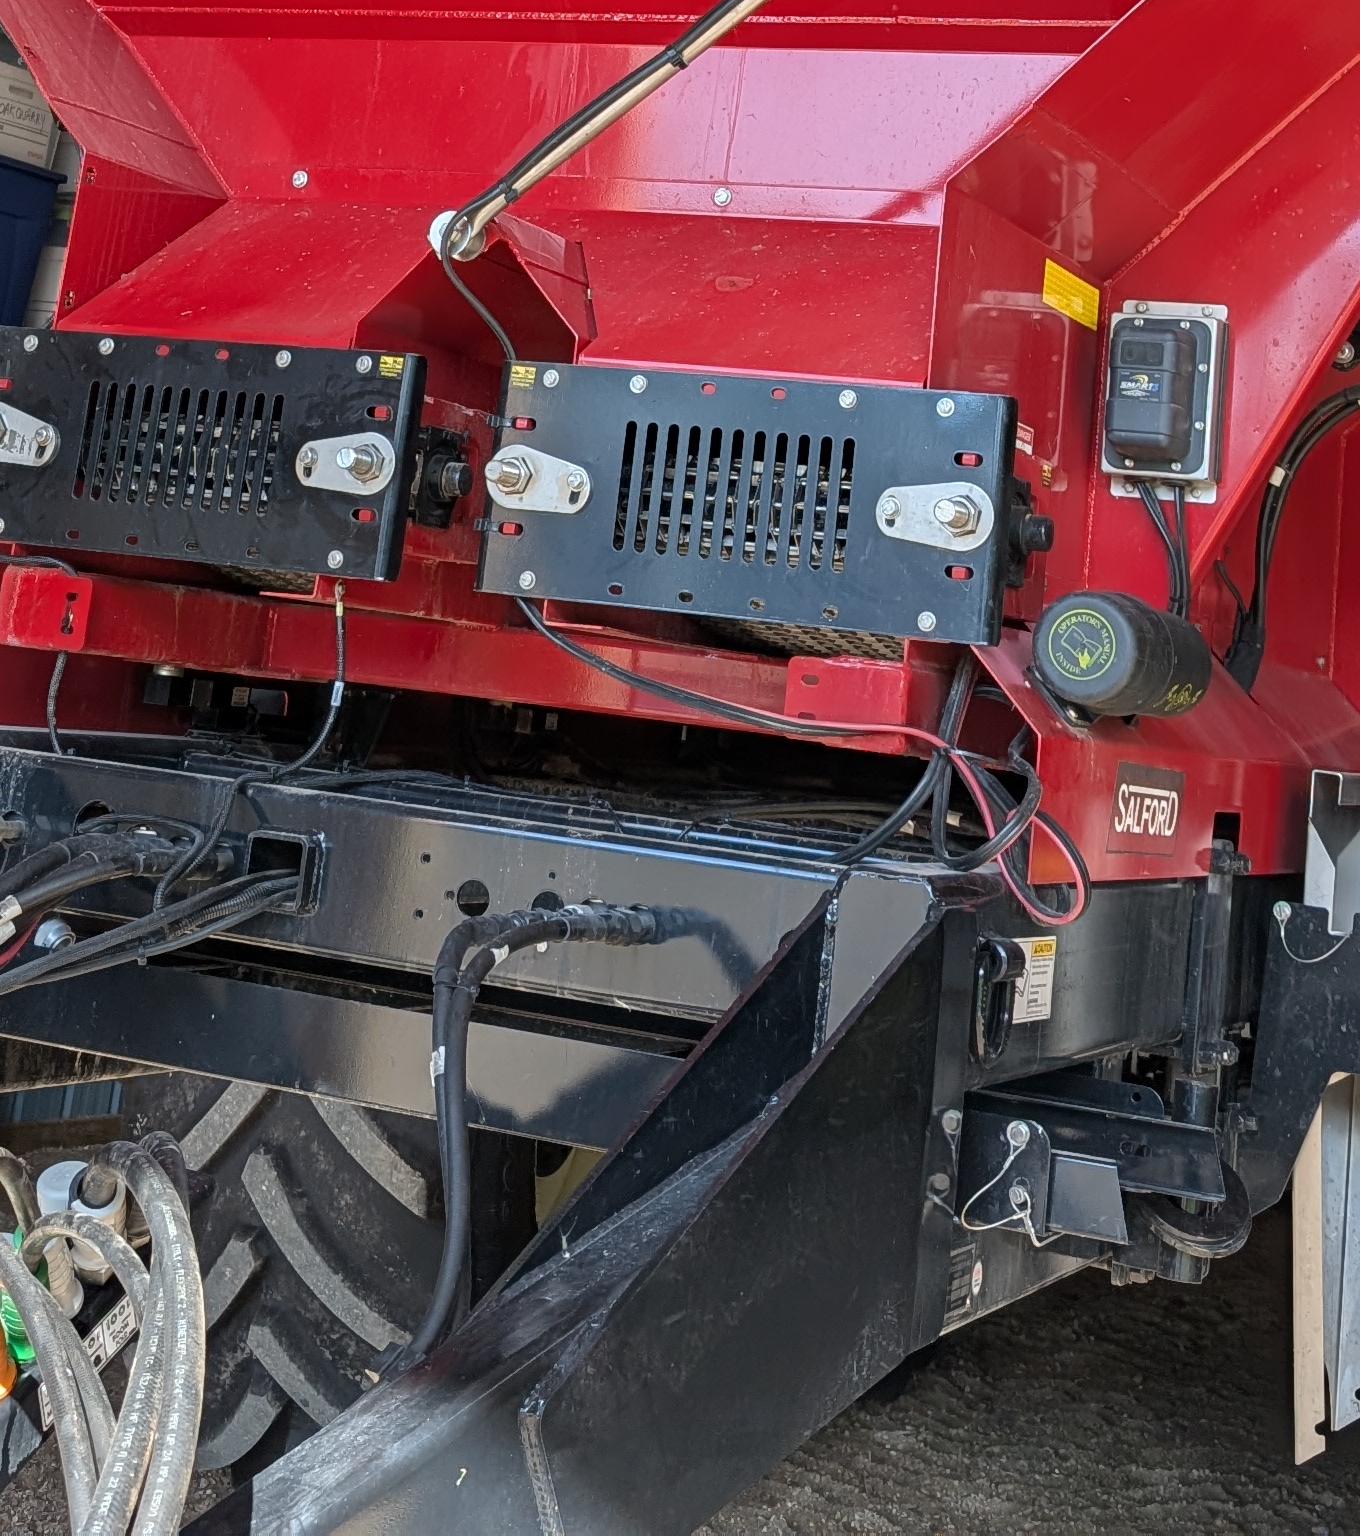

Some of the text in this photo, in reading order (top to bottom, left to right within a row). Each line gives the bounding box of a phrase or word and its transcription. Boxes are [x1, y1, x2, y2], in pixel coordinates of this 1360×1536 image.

[1056, 651, 1081, 674] INSIDE
[1099, 628, 1111, 665] MANUAL
[1114, 783, 1179, 837] SALFORD
